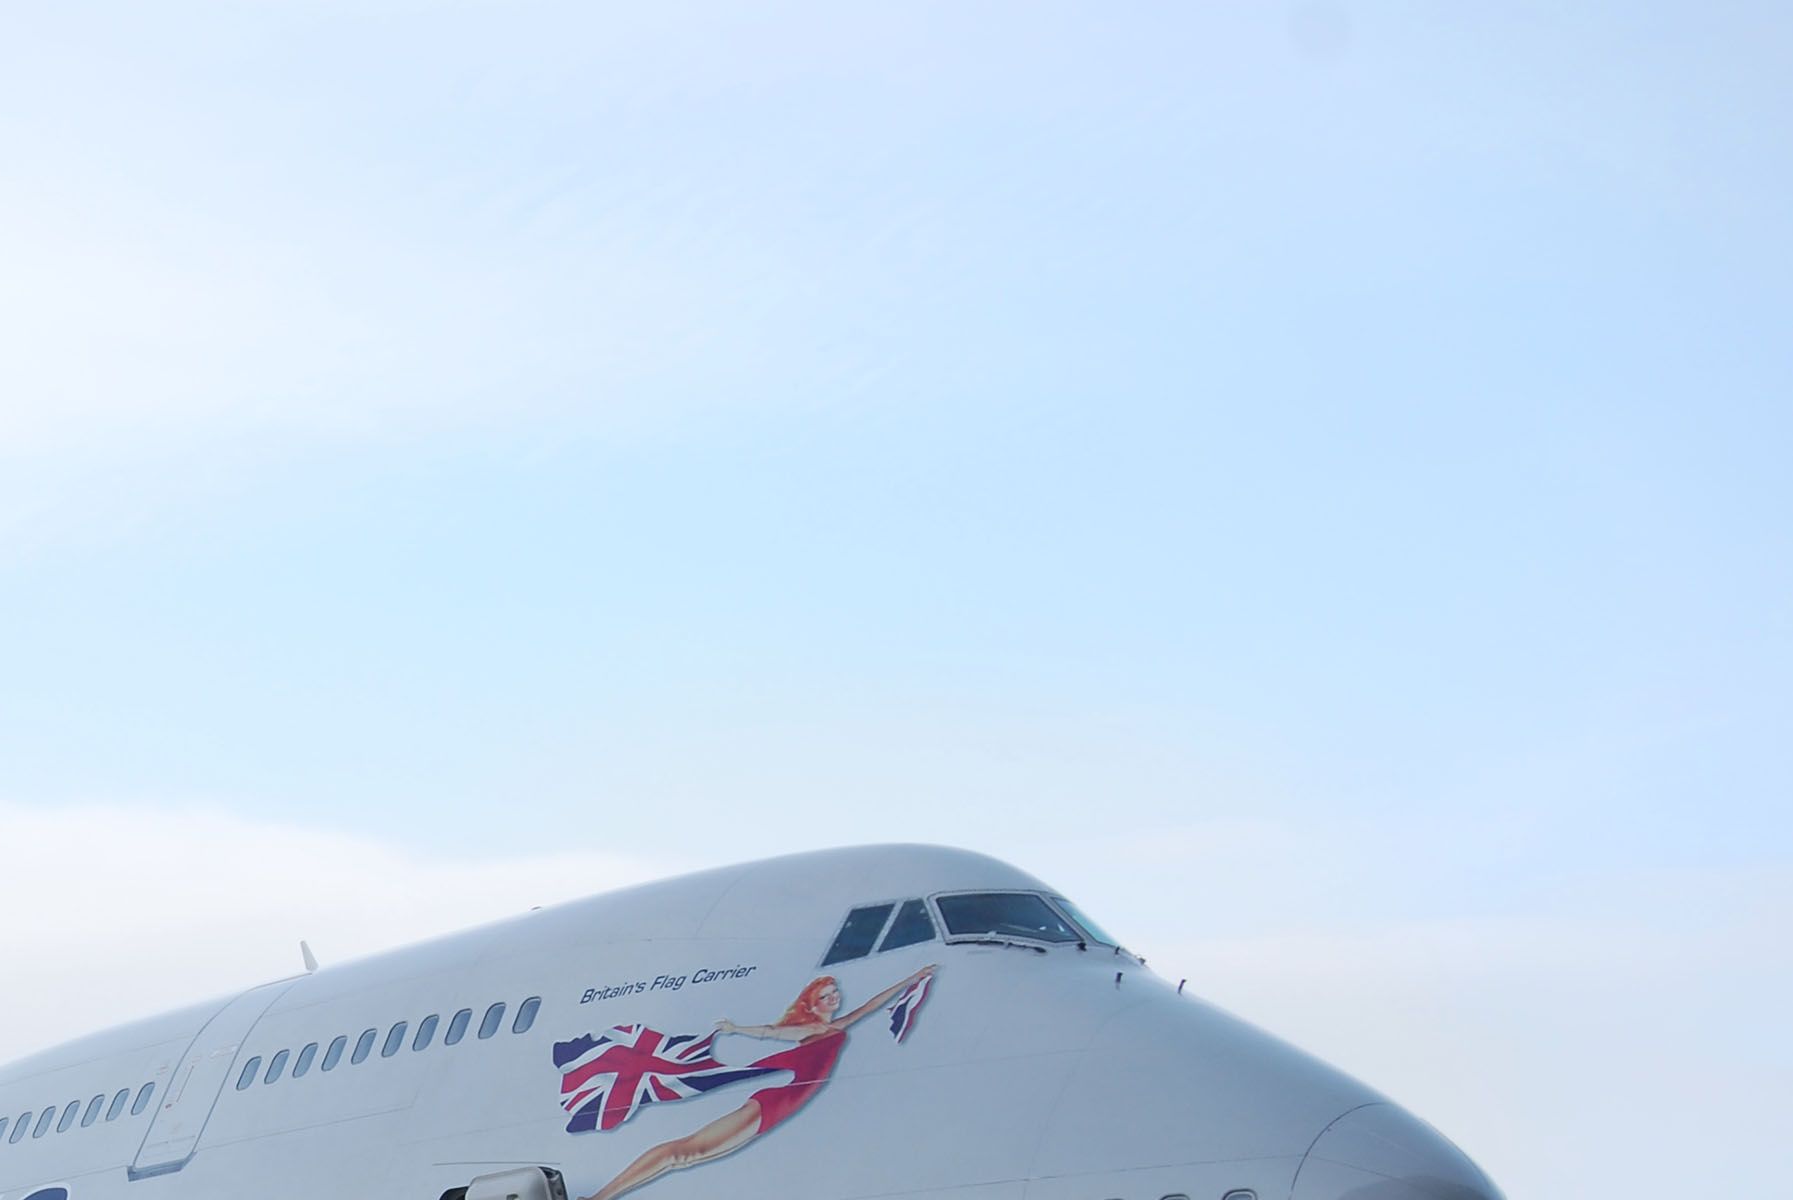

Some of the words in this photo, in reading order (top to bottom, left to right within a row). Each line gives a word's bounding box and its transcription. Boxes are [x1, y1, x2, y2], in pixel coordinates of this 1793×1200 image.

[579, 981, 647, 1005] Britain's
[649, 974, 687, 992] Flag
[691, 963, 757, 984] Carrier
